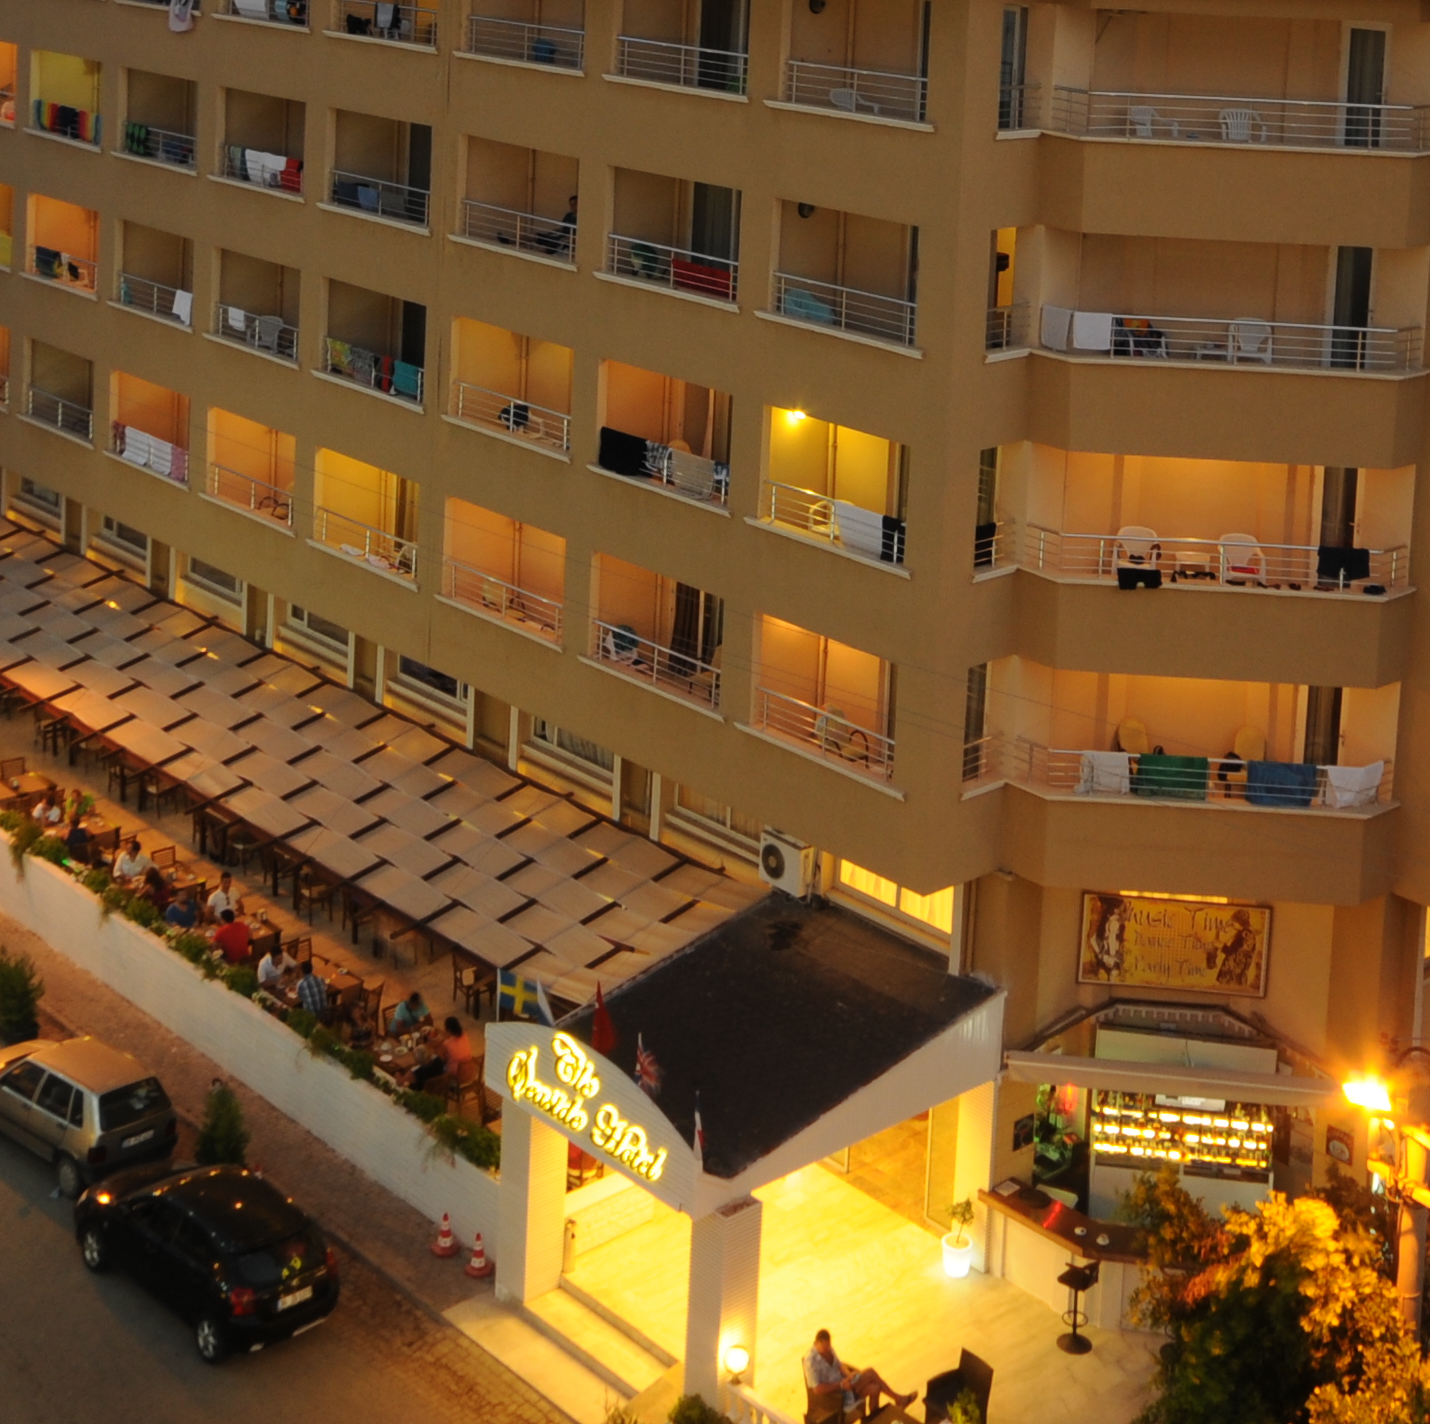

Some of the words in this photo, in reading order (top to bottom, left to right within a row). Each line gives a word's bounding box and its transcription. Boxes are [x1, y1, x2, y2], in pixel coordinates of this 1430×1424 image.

[507, 1045, 589, 1133] Seaside
[591, 1103, 668, 1181] Hotel
[551, 1030, 601, 1099] The
